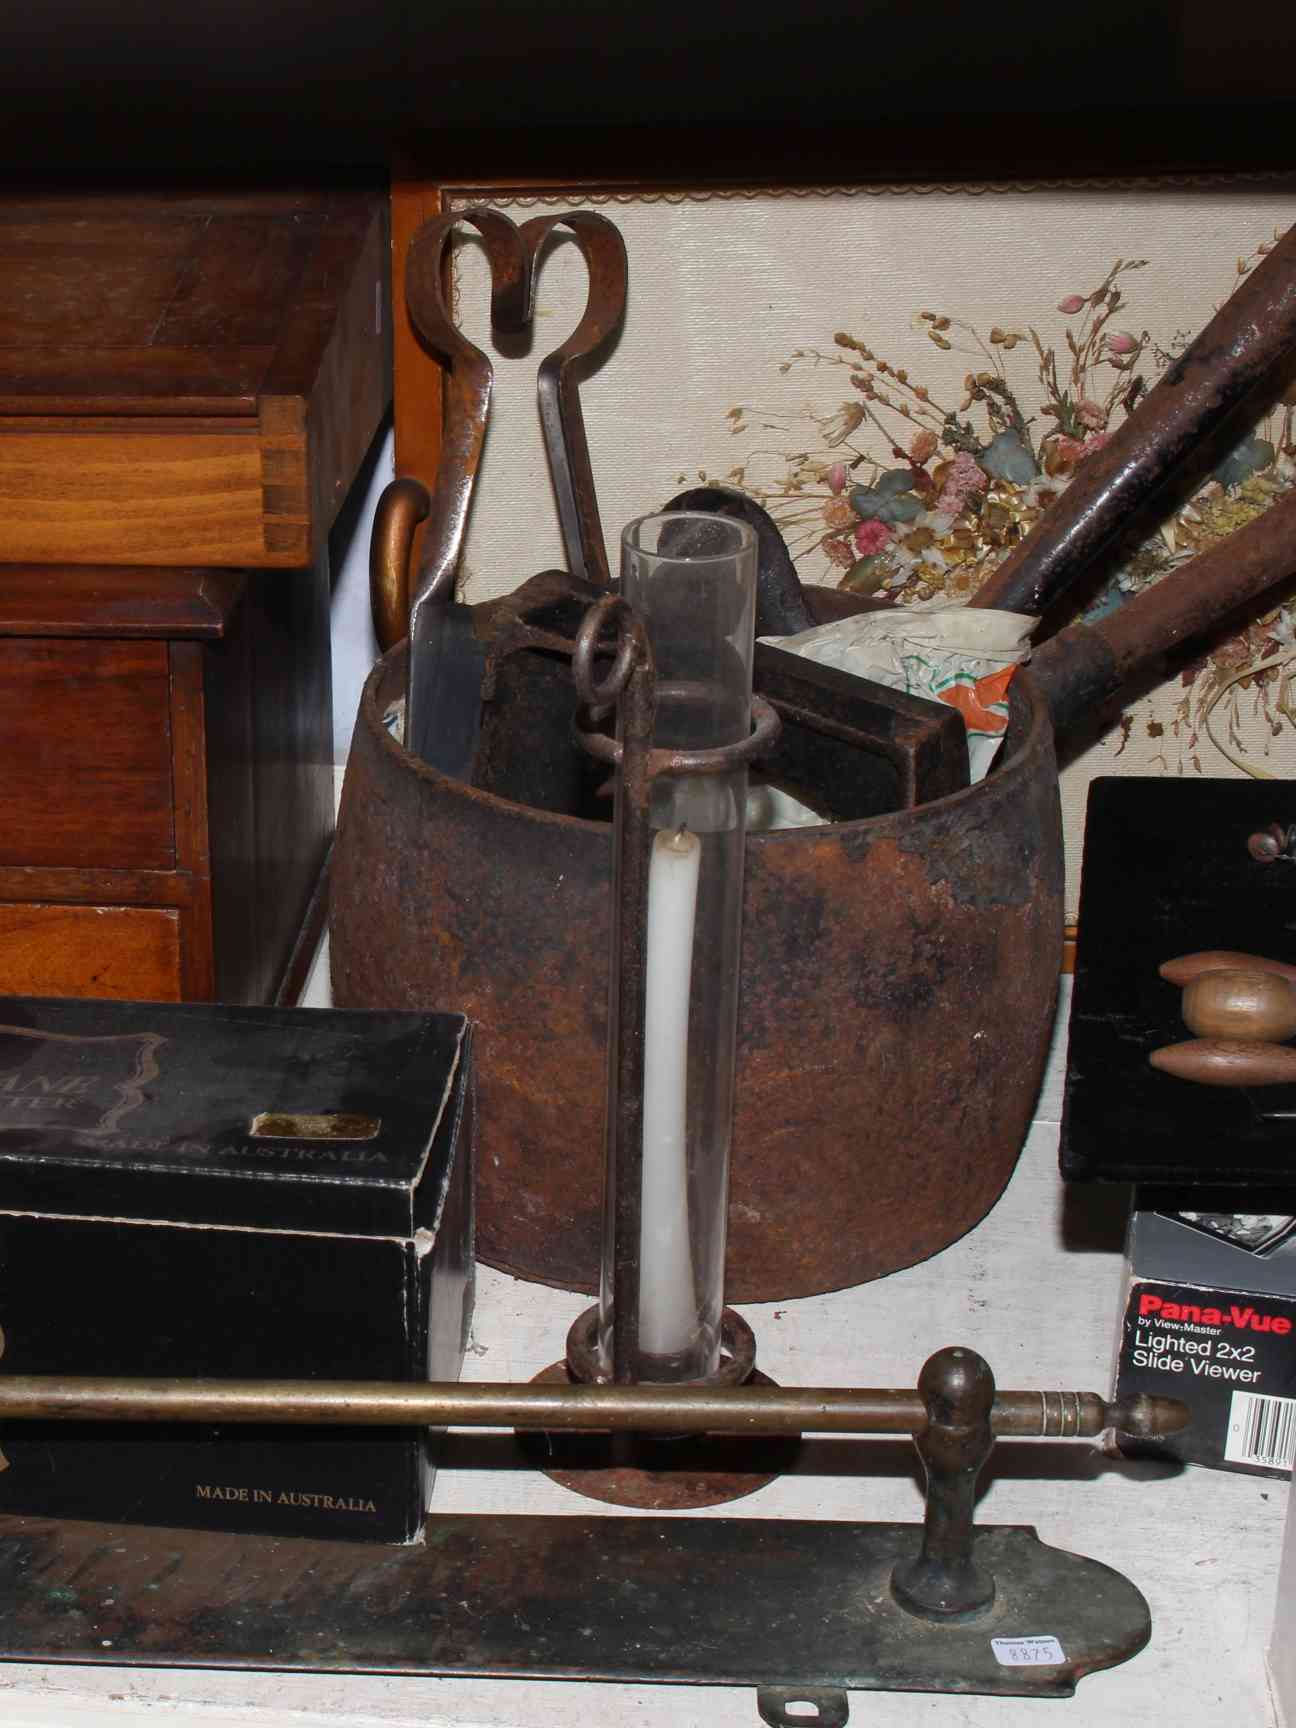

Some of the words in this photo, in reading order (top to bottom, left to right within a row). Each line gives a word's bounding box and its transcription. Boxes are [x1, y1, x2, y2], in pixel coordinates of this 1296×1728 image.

[218, 1144, 390, 1163] AUSTRALIA
[1137, 1316, 1151, 1328] by
[1139, 1293, 1293, 1335] Pana-Vue
[1134, 1330, 1213, 1357] Lighted
[1215, 1342, 1256, 1363] 2x2
[1132, 1350, 1185, 1373] Slide
[1190, 1358, 1263, 1384] Viewer
[196, 1485, 249, 1502] MADE
[254, 1488, 272, 1503] IN
[277, 1491, 377, 1513] AUSTRALIA
